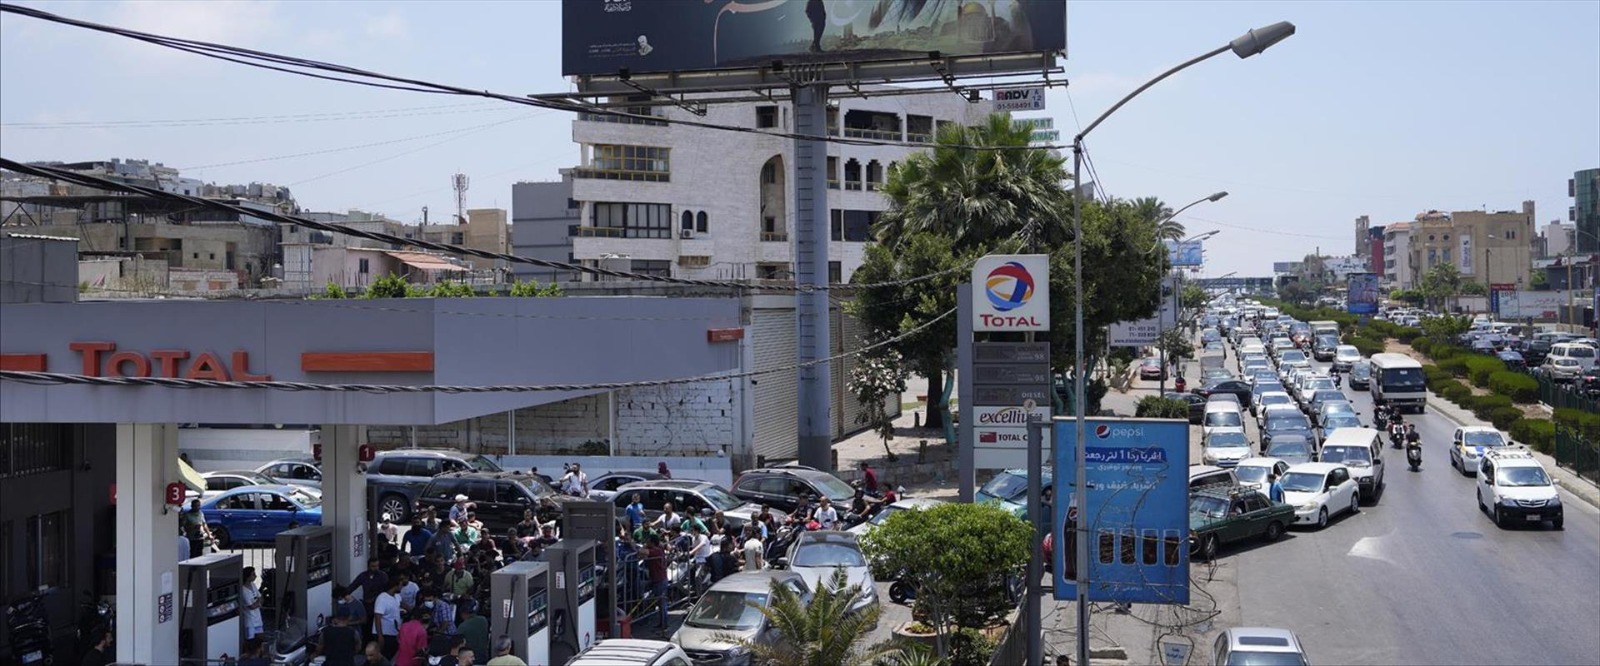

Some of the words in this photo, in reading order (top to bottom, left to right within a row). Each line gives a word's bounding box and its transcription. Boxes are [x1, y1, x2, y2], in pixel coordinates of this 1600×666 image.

[980, 314, 1041, 327] TOTAL
[69, 341, 273, 383] TOTAL
[1112, 426, 1144, 438] pepsi
[363, 447, 370, 458] 1
[172, 487, 180, 501] 3
